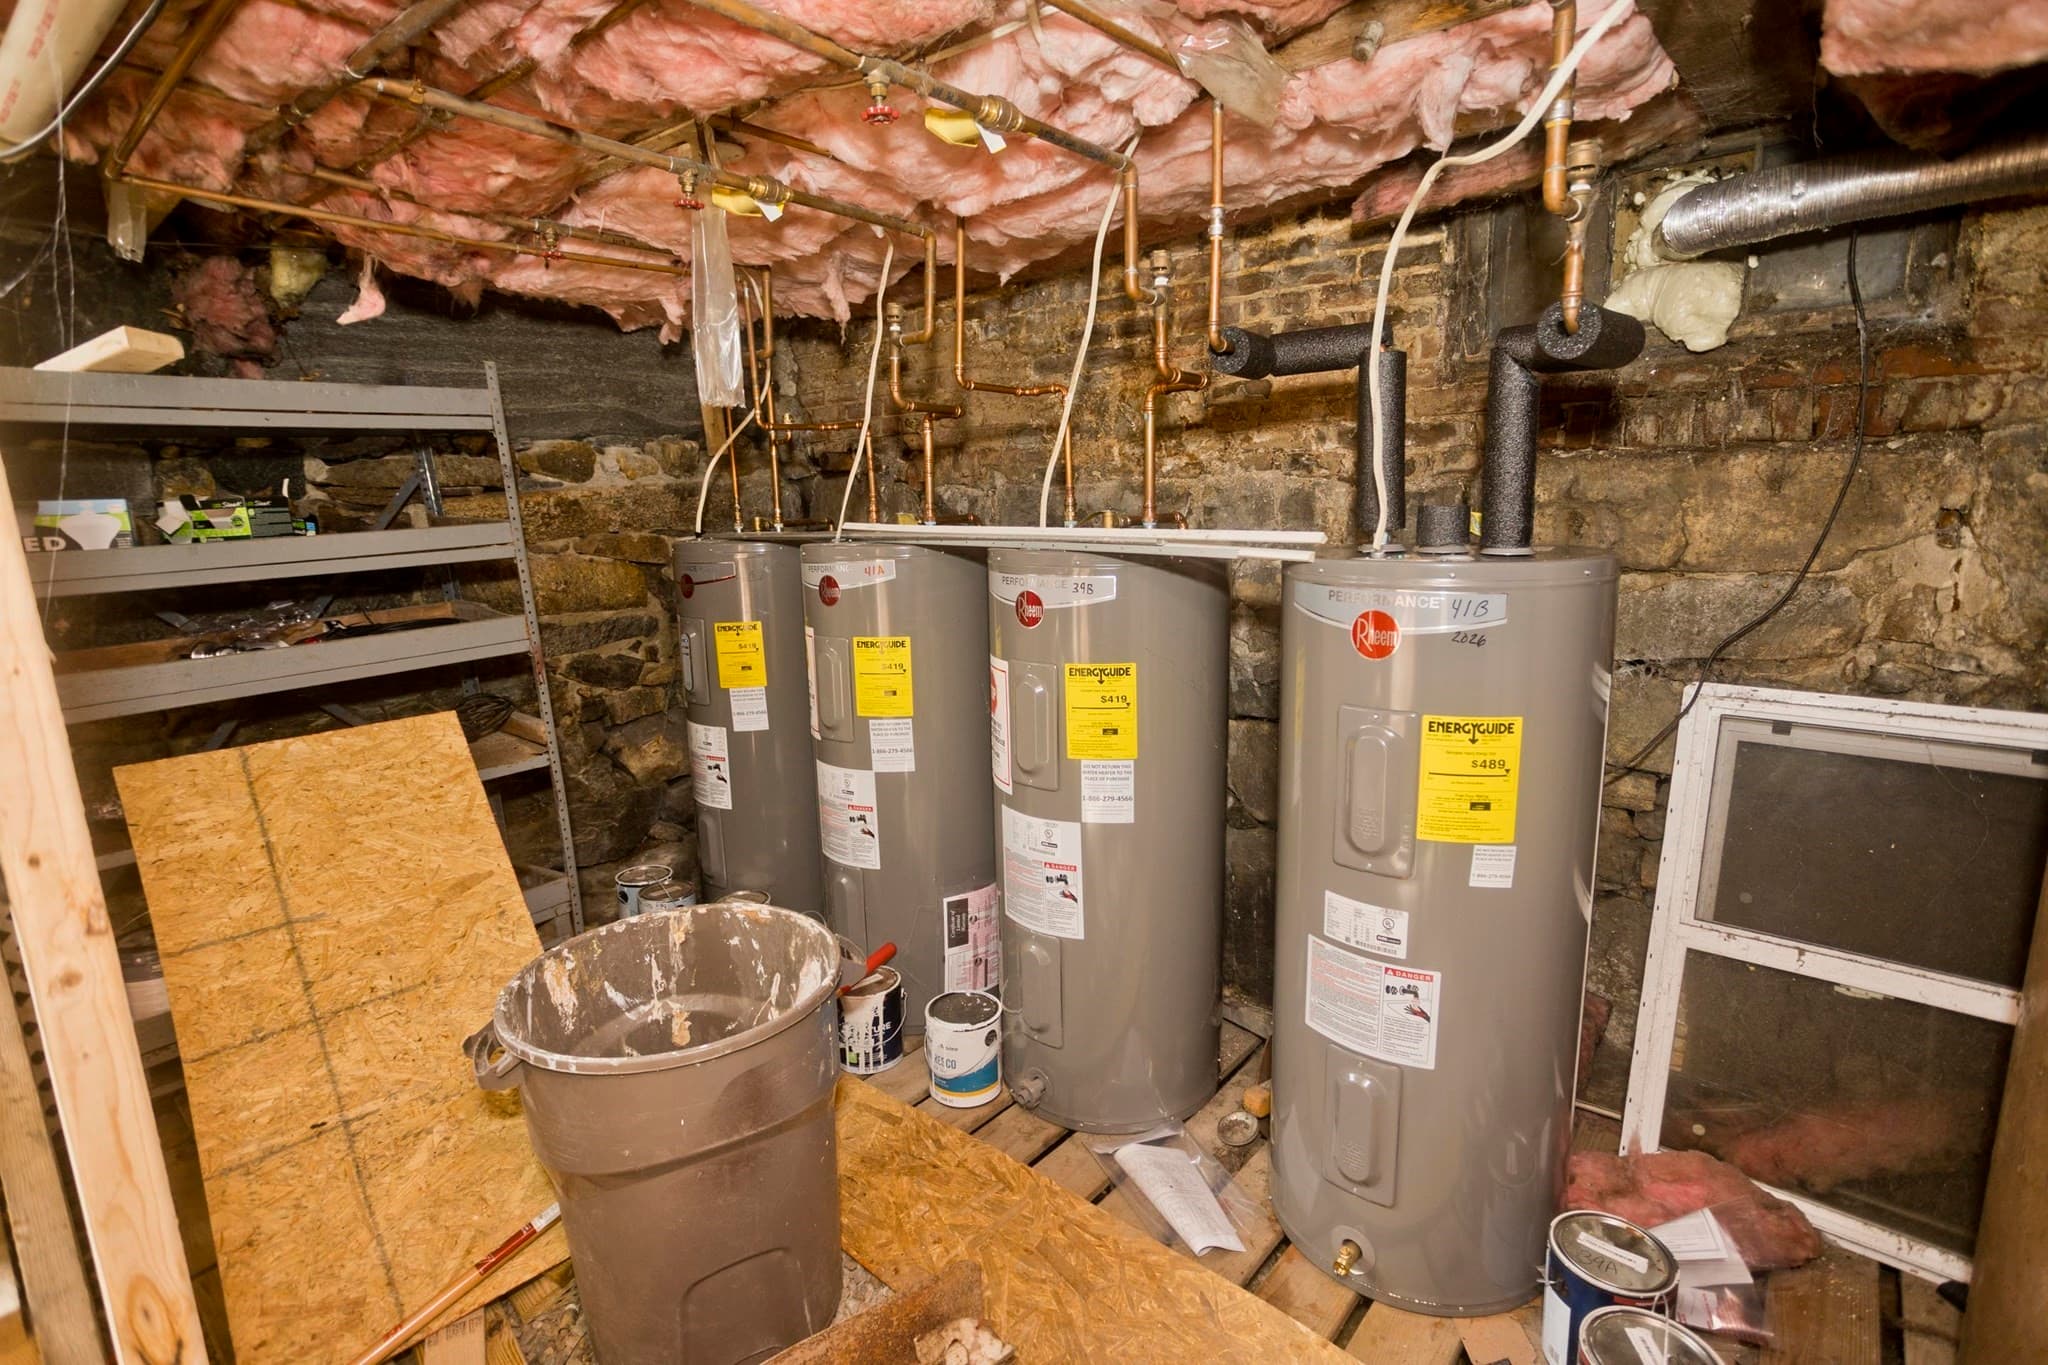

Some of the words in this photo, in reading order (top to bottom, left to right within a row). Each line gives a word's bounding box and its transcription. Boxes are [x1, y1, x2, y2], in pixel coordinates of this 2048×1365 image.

[23, 536, 66, 552] ED
[864, 565, 885, 576] 41A
[1018, 591, 1042, 622] Rheem
[1452, 599, 1489, 619] 41B
[1356, 611, 1398, 652] Rheem
[1451, 631, 1487, 648] 2026
[1069, 667, 1131, 677] ENERGYGUIDE
[1101, 695, 1127, 704] $419
[1428, 721, 1515, 734] ENERGYGUIDE
[1472, 760, 1506, 770] $489
[1395, 971, 1432, 982] DANGER
